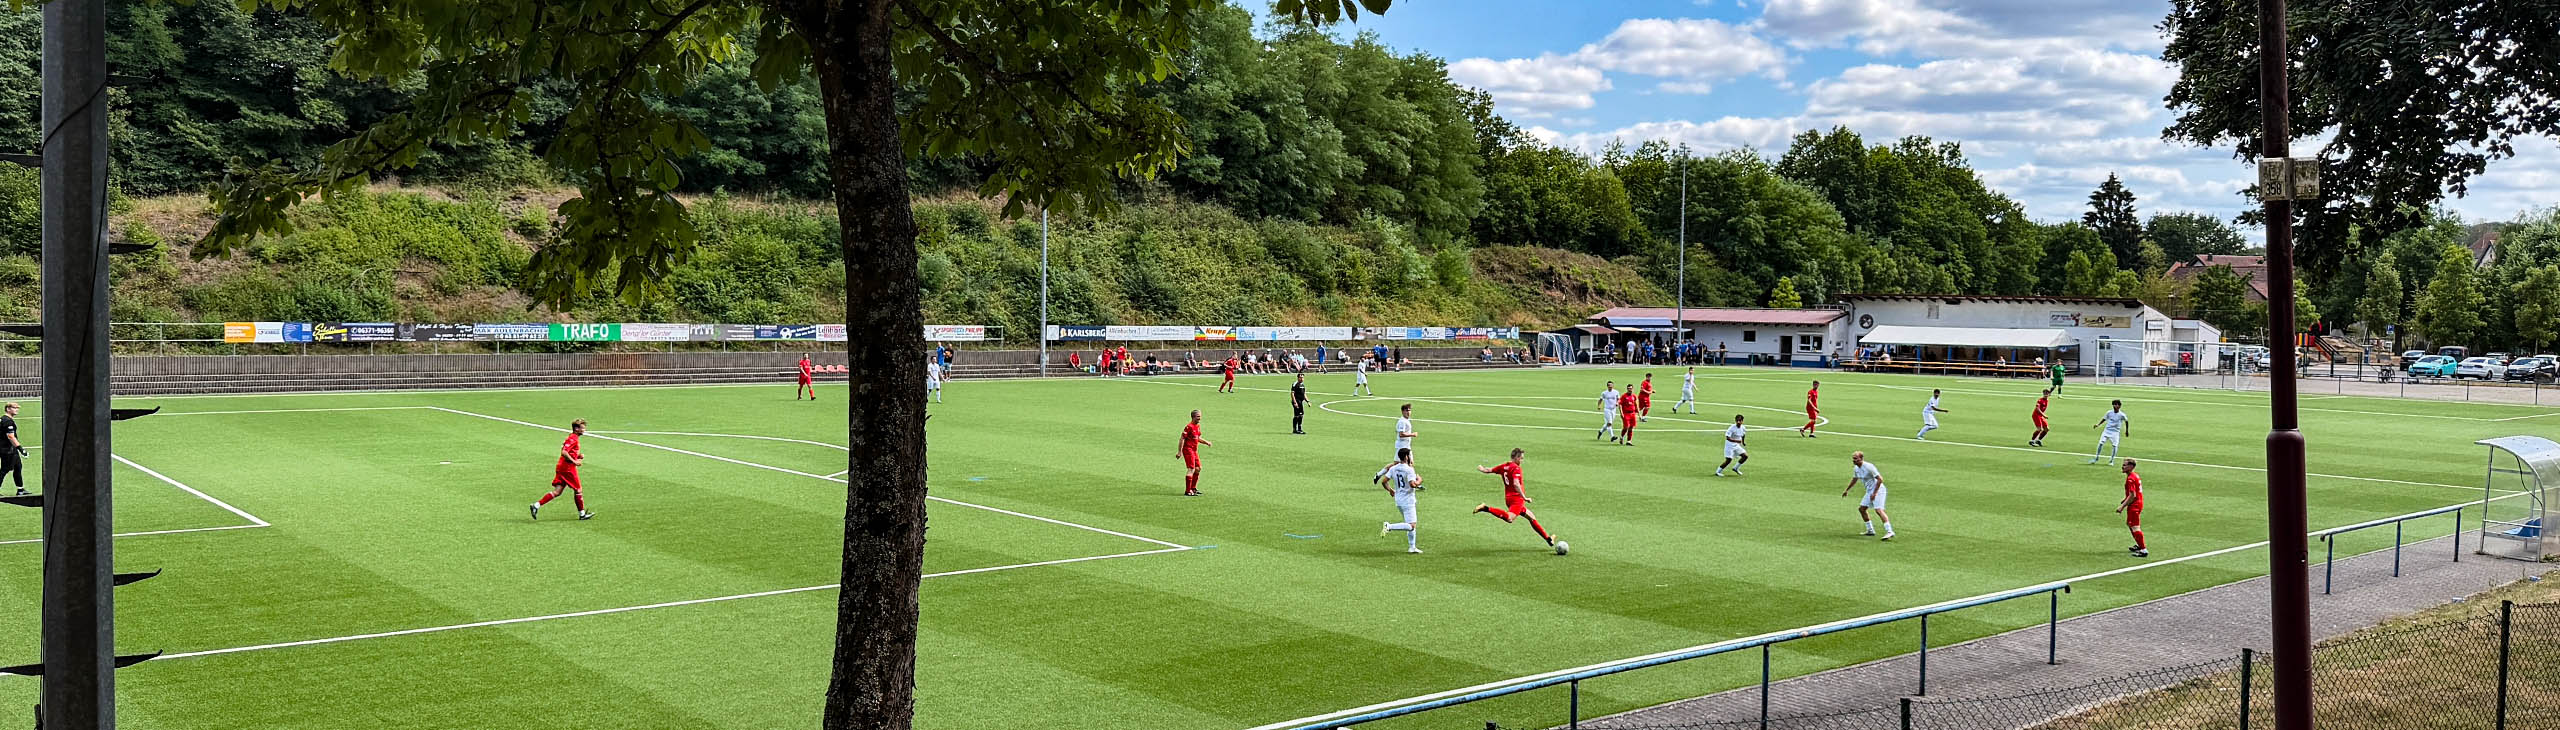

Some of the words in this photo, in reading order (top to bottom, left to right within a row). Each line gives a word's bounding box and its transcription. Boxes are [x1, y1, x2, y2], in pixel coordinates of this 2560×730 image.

[2265, 182, 2282, 196] 358
[561, 323, 609, 338] TRAFO
[1067, 328, 1106, 337] KARLSBERG
[1205, 327, 1227, 336] Krupp
[1396, 473, 1406, 489] 13
[1503, 471, 1510, 486] 6
